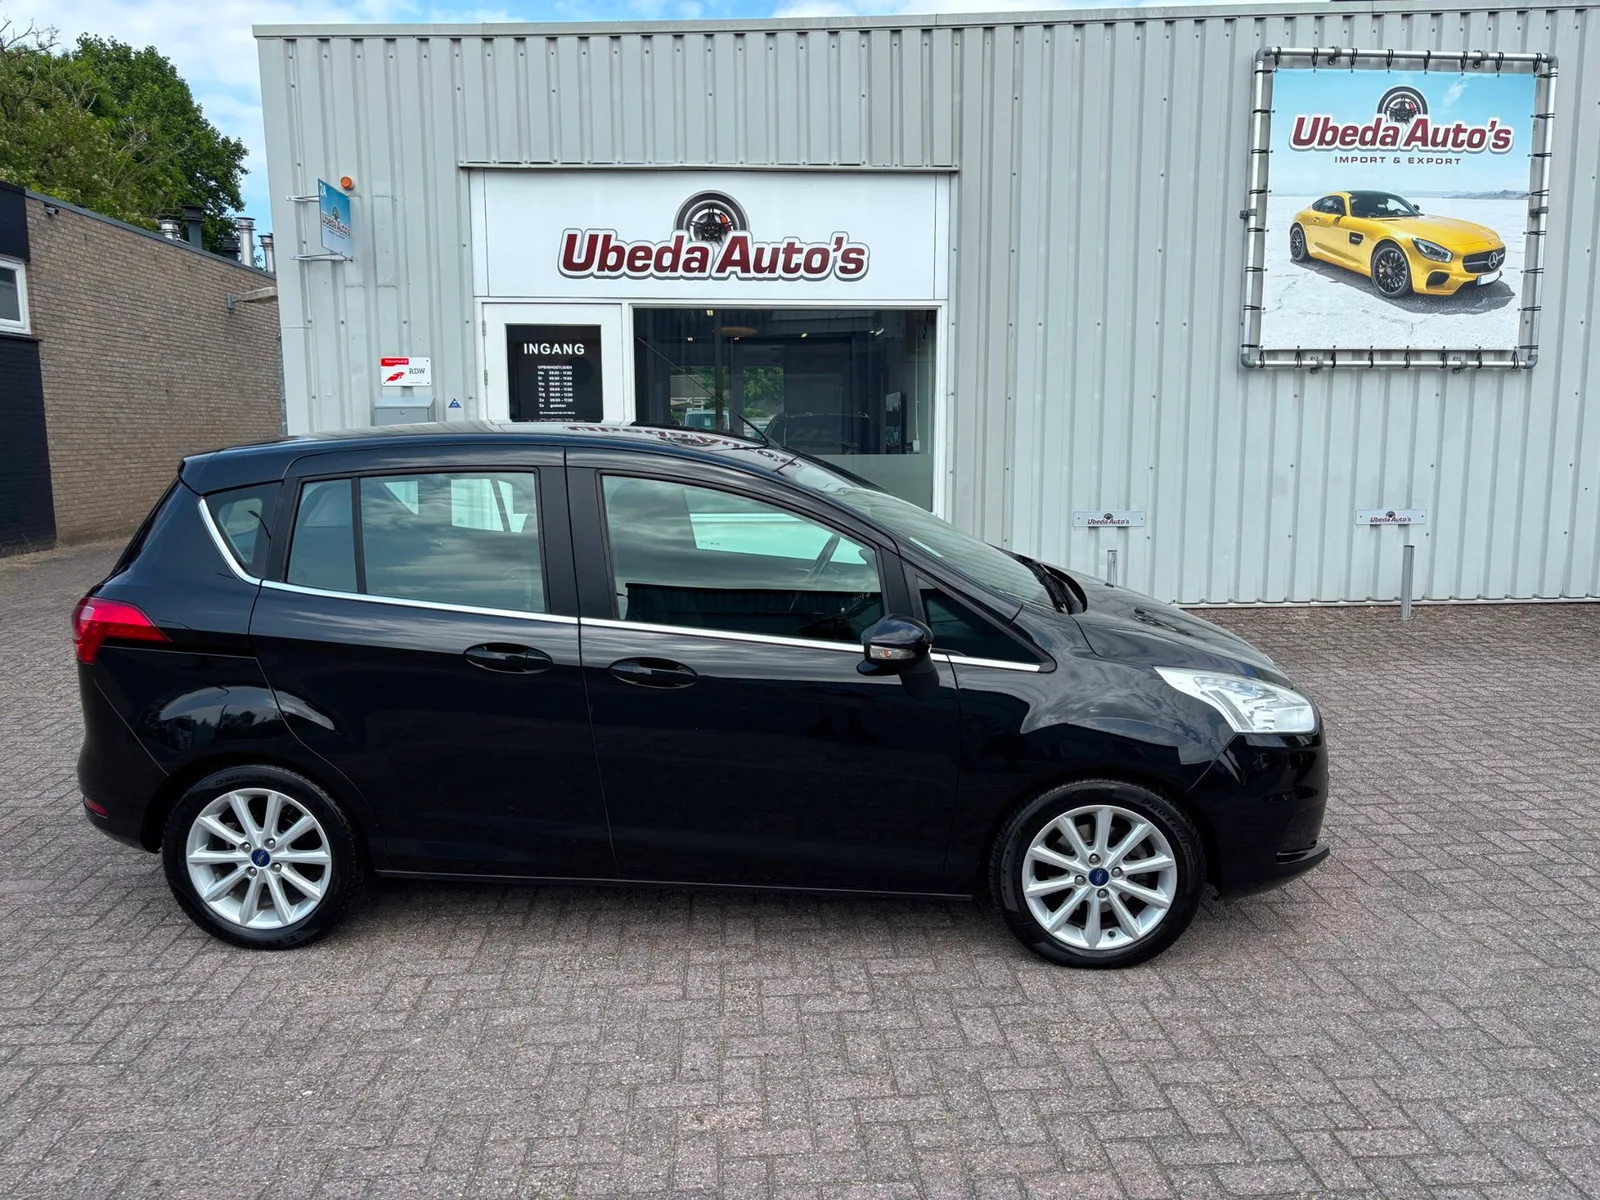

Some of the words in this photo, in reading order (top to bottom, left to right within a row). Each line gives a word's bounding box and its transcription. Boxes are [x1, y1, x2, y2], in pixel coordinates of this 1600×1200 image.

[1291, 116, 1400, 148] Ubeda
[1403, 117, 1513, 150] Auto's
[1334, 156, 1386, 164] IMPORT
[1393, 156, 1401, 164] &
[1408, 157, 1462, 165] EXPORT
[561, 232, 710, 274] Ubeda
[715, 232, 869, 276] Auto's
[523, 342, 585, 355] INGANG
[408, 367, 426, 375] RDW
